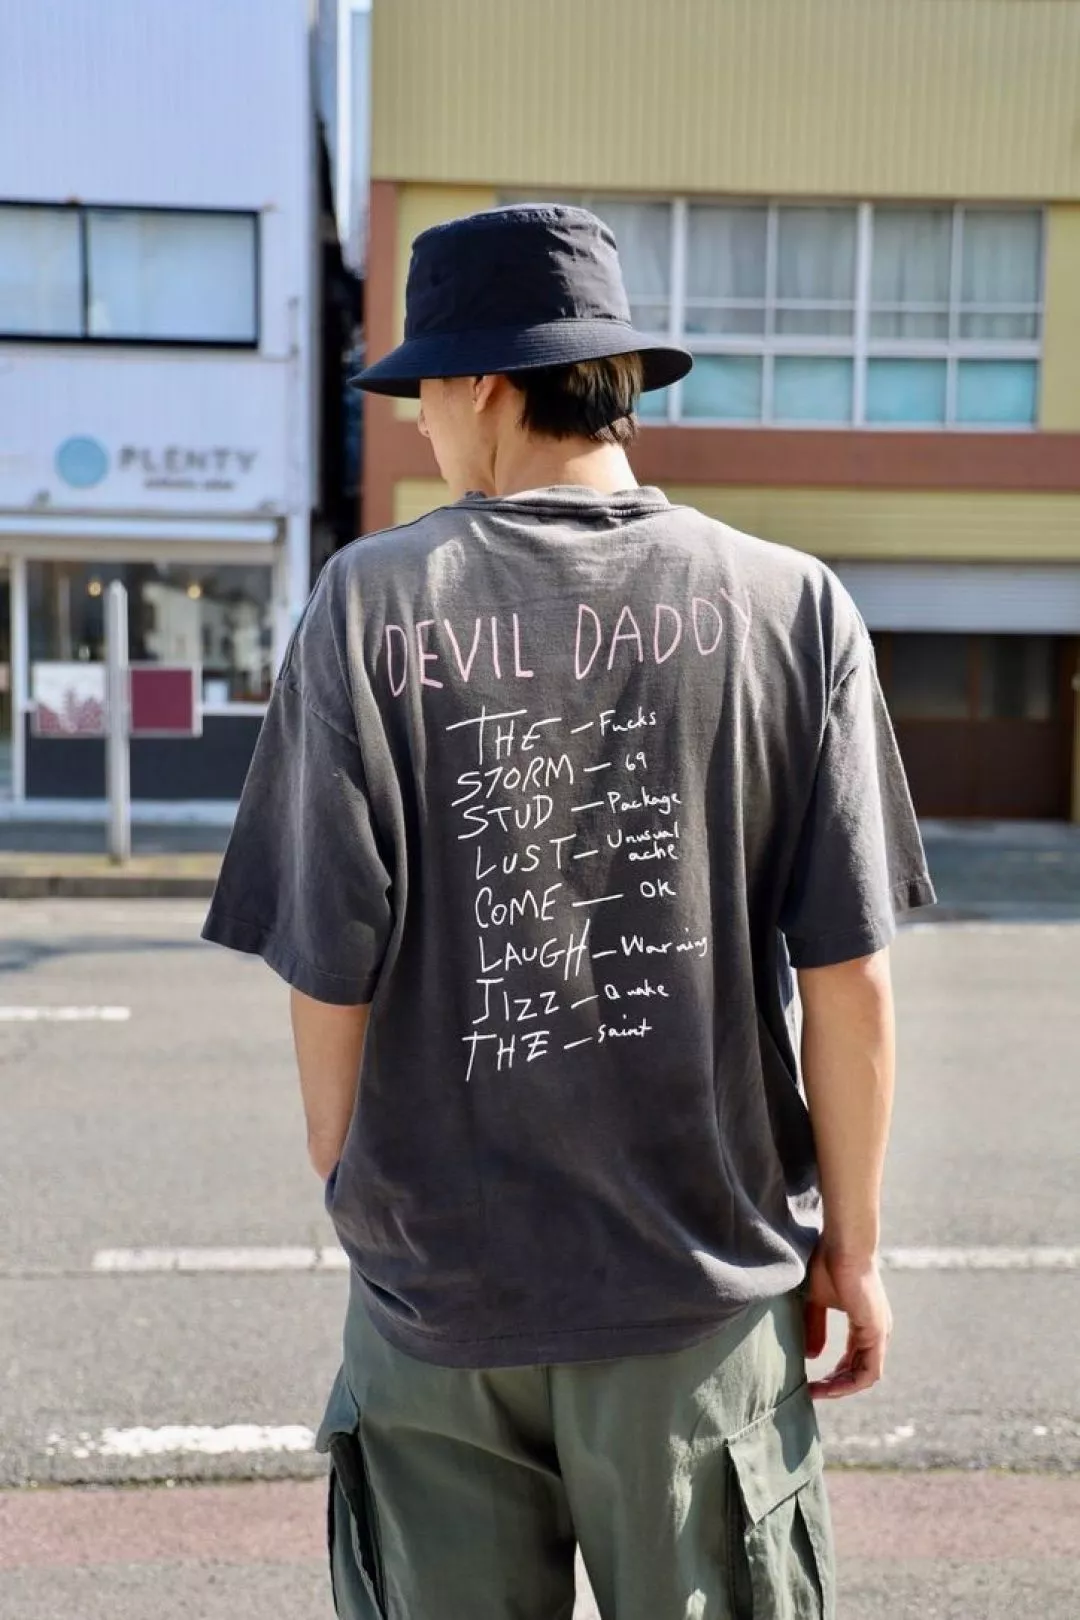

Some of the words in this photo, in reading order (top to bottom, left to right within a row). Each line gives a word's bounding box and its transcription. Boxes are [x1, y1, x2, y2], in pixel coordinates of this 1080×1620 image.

[118, 444, 257, 473] PLENTY
[385, 613, 534, 697] DEVIL
[575, 588, 752, 681] DADDY
[446, 705, 562, 766] THE
[599, 706, 657, 737] Fucks
[451, 754, 574, 807] STORM
[624, 751, 647, 771] 69
[457, 794, 553, 840] STUD
[606, 786, 682, 814] Package
[475, 833, 577, 881] LUST
[475, 882, 563, 928] COME
[478, 918, 591, 981] LAUGH
[620, 927, 708, 957] Warning
[472, 978, 560, 1025] JIZZ
[604, 979, 670, 1001] Quake
[461, 1030, 550, 1083] THE
